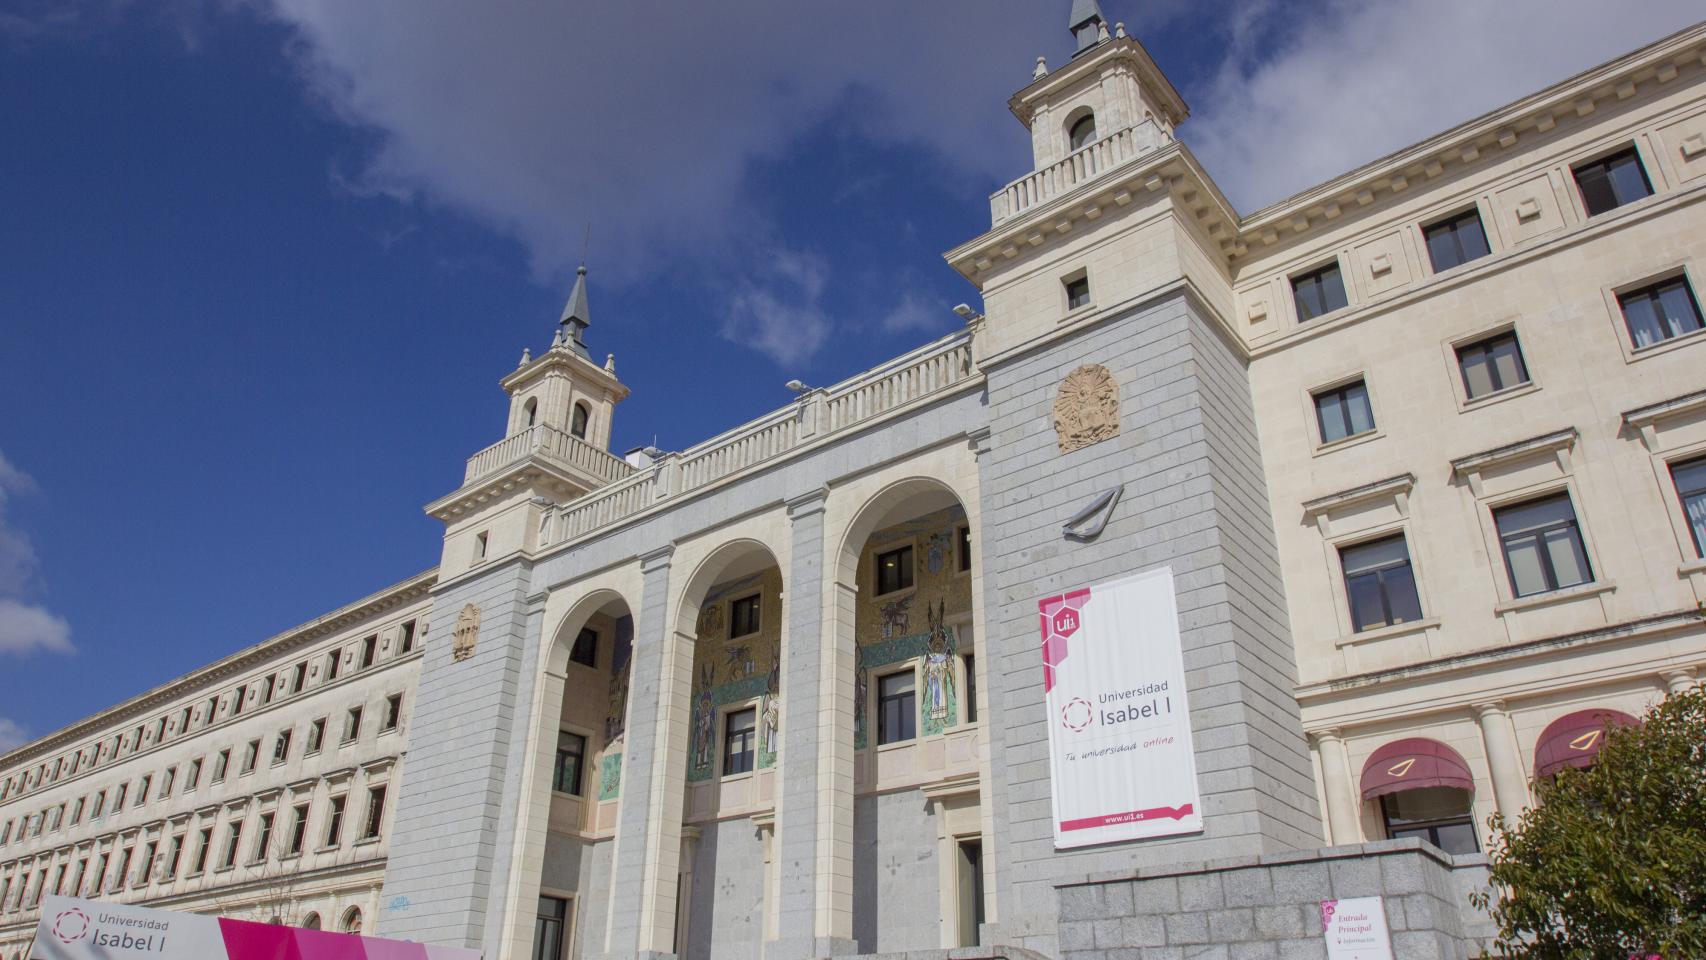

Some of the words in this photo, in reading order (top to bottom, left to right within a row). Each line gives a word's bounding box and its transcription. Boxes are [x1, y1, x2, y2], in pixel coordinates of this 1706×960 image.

[1099, 681, 1168, 704] Universidad
[1100, 699, 1159, 726] Isabel
[1166, 697, 1171, 713] I
[1066, 752, 1076, 762] Tu
[1081, 742, 1137, 760] universidad
[1143, 735, 1175, 748] online
[1105, 812, 1144, 824] www.ui1.es
[98, 913, 169, 931] Universidad
[1338, 913, 1368, 922] Entrada
[1338, 924, 1372, 934] Principal
[92, 928, 153, 951] Isabel
[159, 937, 165, 952] I
